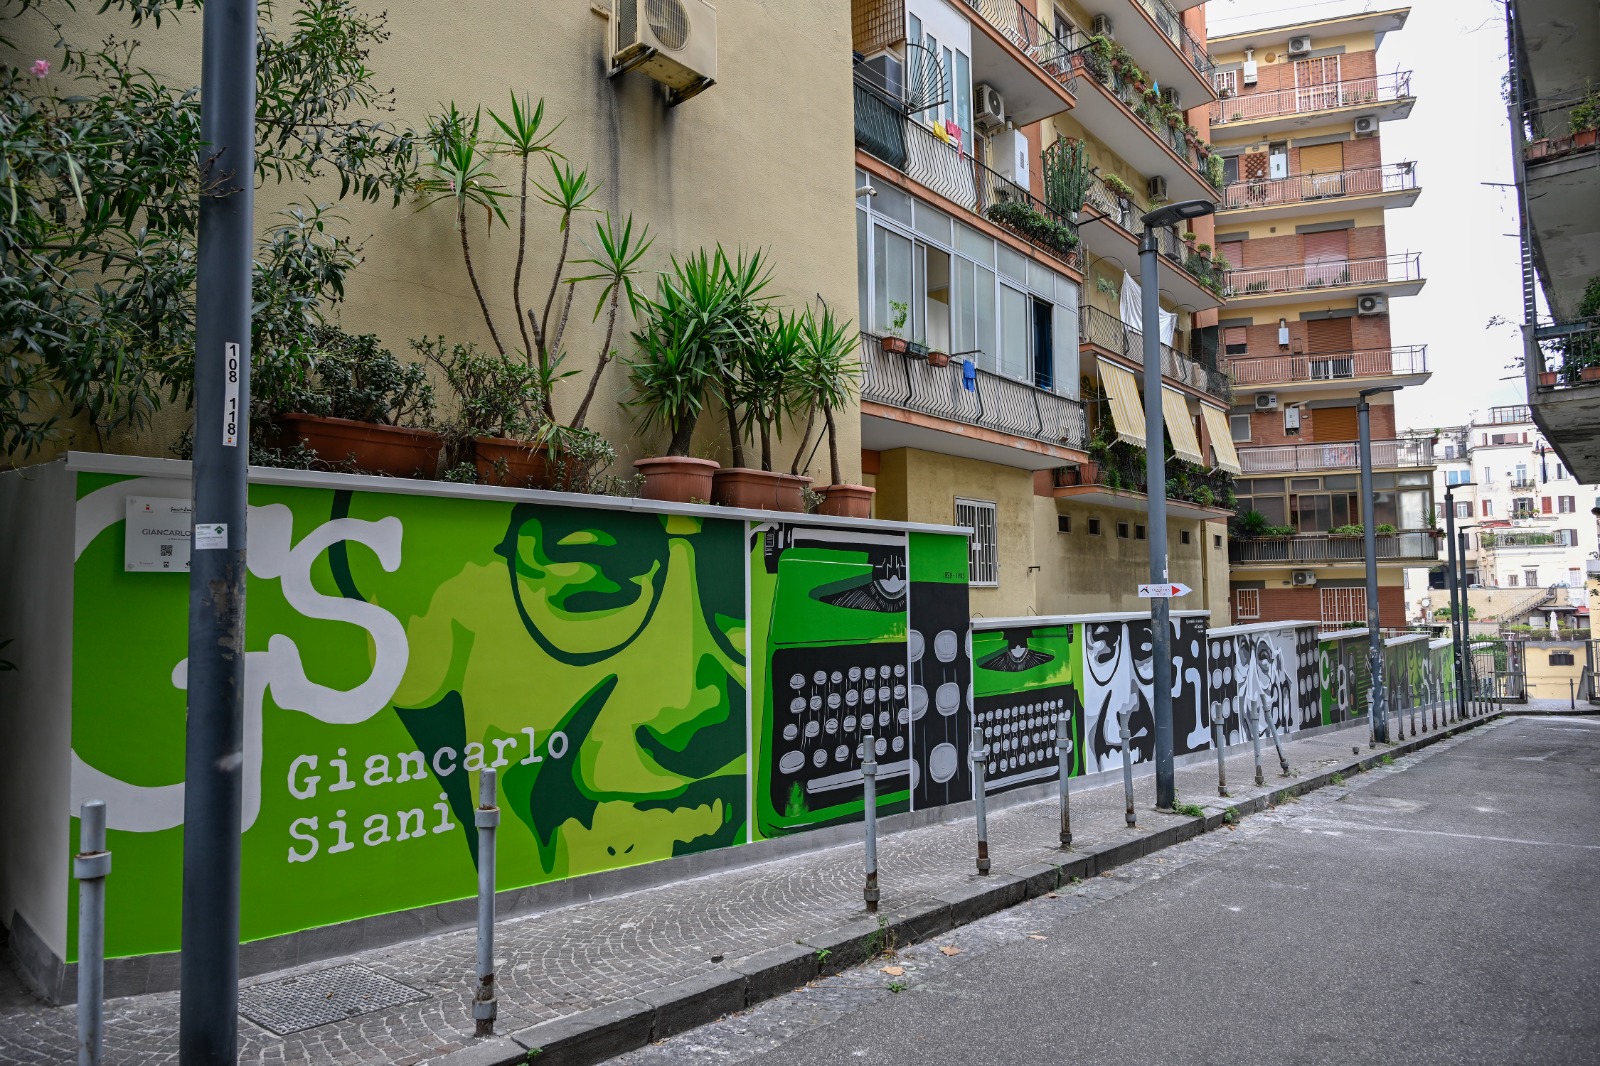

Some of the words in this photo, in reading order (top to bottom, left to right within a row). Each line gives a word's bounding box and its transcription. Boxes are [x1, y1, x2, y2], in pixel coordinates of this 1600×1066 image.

[228, 344, 238, 383] 108
[227, 397, 237, 436] 118
[141, 528, 192, 537] GIANCARLO
[286, 726, 569, 800] Giancarlo
[286, 792, 456, 864] Siani
